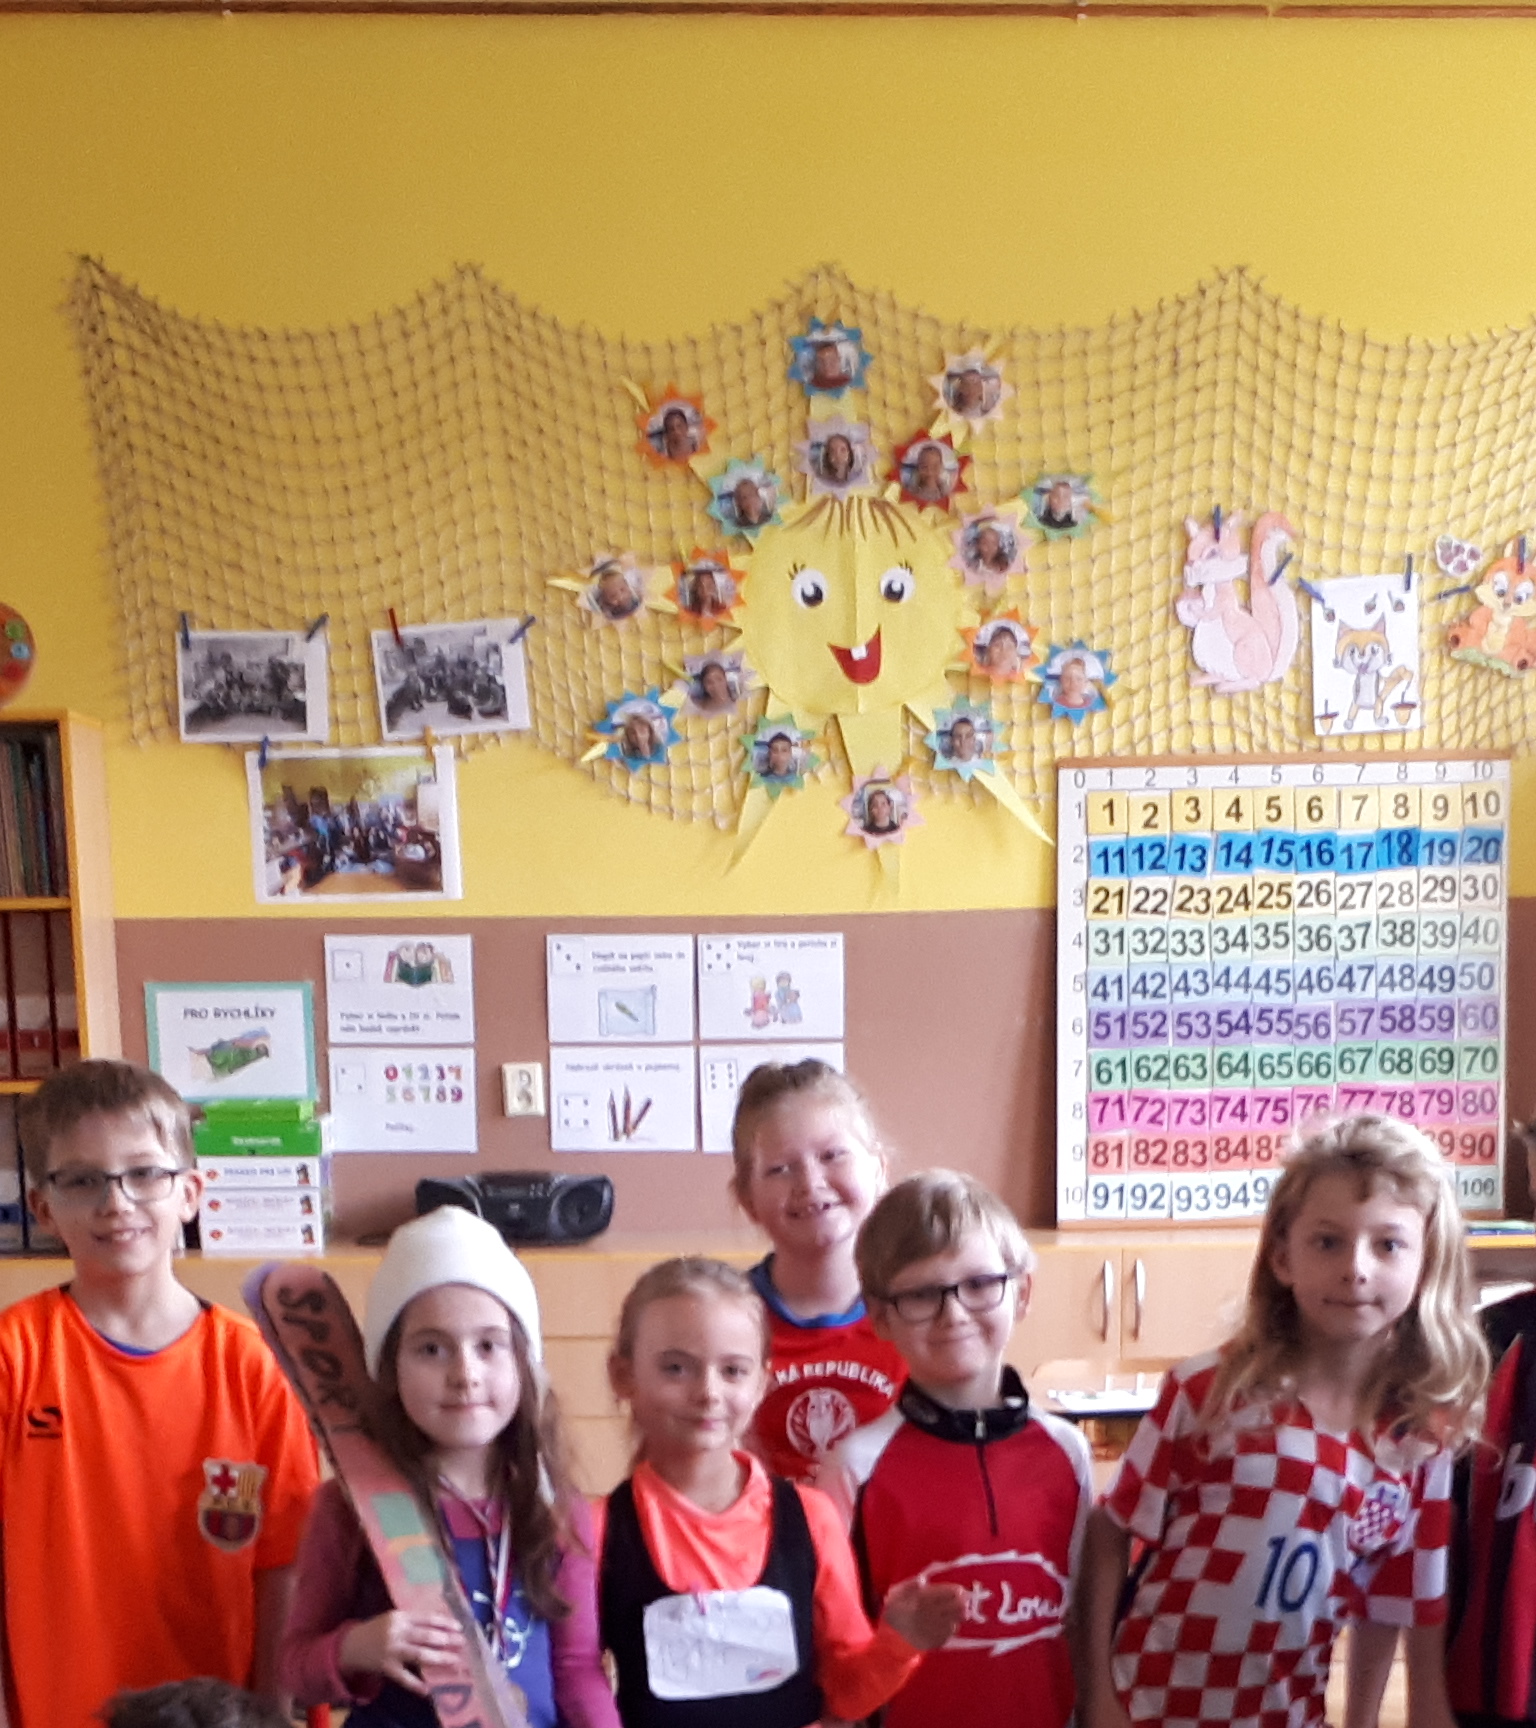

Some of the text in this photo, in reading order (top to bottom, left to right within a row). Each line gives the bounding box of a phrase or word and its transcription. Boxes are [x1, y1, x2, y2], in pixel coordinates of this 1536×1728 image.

[1074, 762, 1493, 788] 0 1 2 3 4 5 6 7 8 9 10
[1075, 791, 1500, 829] 1 1 2 3 4 5 6 7 8 9 10
[1073, 830, 1500, 875] 2 11 12 13 14 15 16 17 18 19 20
[1092, 886, 1124, 916] 21
[1132, 886, 1168, 915] 22
[1176, 885, 1211, 914] 23
[1216, 883, 1251, 913] 24
[1257, 882, 1292, 911] 25
[1297, 880, 1331, 908] 26
[1339, 882, 1372, 910] 27
[1378, 881, 1414, 909] 28
[1422, 875, 1456, 903] 29
[1463, 874, 1498, 900] 30
[1072, 917, 1499, 957] 4 31 32 33 34 35 36 37 38 39 40
[1092, 975, 1123, 1002] 41
[1131, 972, 1167, 999] 42
[1173, 969, 1209, 997] 43
[1215, 966, 1251, 993] 44
[1254, 969, 1291, 996] 45
[1298, 967, 1333, 995] 46
[1338, 964, 1374, 994] 47
[1379, 964, 1414, 992] 48
[1418, 964, 1455, 994] 49
[1459, 962, 1494, 990] 50
[1094, 1012, 1126, 1040] 51
[1132, 1010, 1167, 1039] 52
[1176, 1011, 1211, 1040] 53
[1217, 1009, 1251, 1038] 54
[1256, 1008, 1293, 1036] 55
[1293, 1011, 1331, 1040] 56
[1339, 1007, 1375, 1035] 57
[1380, 1004, 1415, 1033] 58
[1419, 1005, 1455, 1033] 59
[1464, 1003, 1498, 1031] 60
[1096, 1056, 1127, 1085] 61
[1134, 1054, 1170, 1082] 62
[1173, 1053, 1207, 1081] 63
[1217, 1052, 1251, 1079] 64
[1258, 1052, 1293, 1080] 65
[1297, 1051, 1331, 1079] 66
[1339, 1047, 1373, 1074] 67
[1379, 1047, 1413, 1075] 68
[1420, 1046, 1455, 1074] 69
[1464, 1046, 1497, 1073] 70
[1092, 1095, 1124, 1124] 71
[1133, 1096, 1166, 1126] 72
[1174, 1098, 1206, 1125] 73
[1212, 1095, 1248, 1123] 74
[1254, 1097, 1289, 1124] 75
[1381, 1090, 1415, 1118] 78
[1419, 1088, 1454, 1116] 79
[1462, 1088, 1497, 1116] 80
[1092, 1140, 1123, 1168] 81
[1134, 1139, 1167, 1166] 82
[1172, 1139, 1207, 1167] 83
[1214, 1135, 1250, 1163] 84
[1459, 1133, 1495, 1159] 90
[1093, 1183, 1124, 1210] 91
[1131, 1183, 1165, 1210] 92
[1175, 1185, 1211, 1212] 93
[1214, 1182, 1250, 1210] 94
[1464, 1178, 1495, 1196] 100
[803, 1360, 896, 1399] REPUBLIKA
[1254, 1536, 1319, 1613] 10
